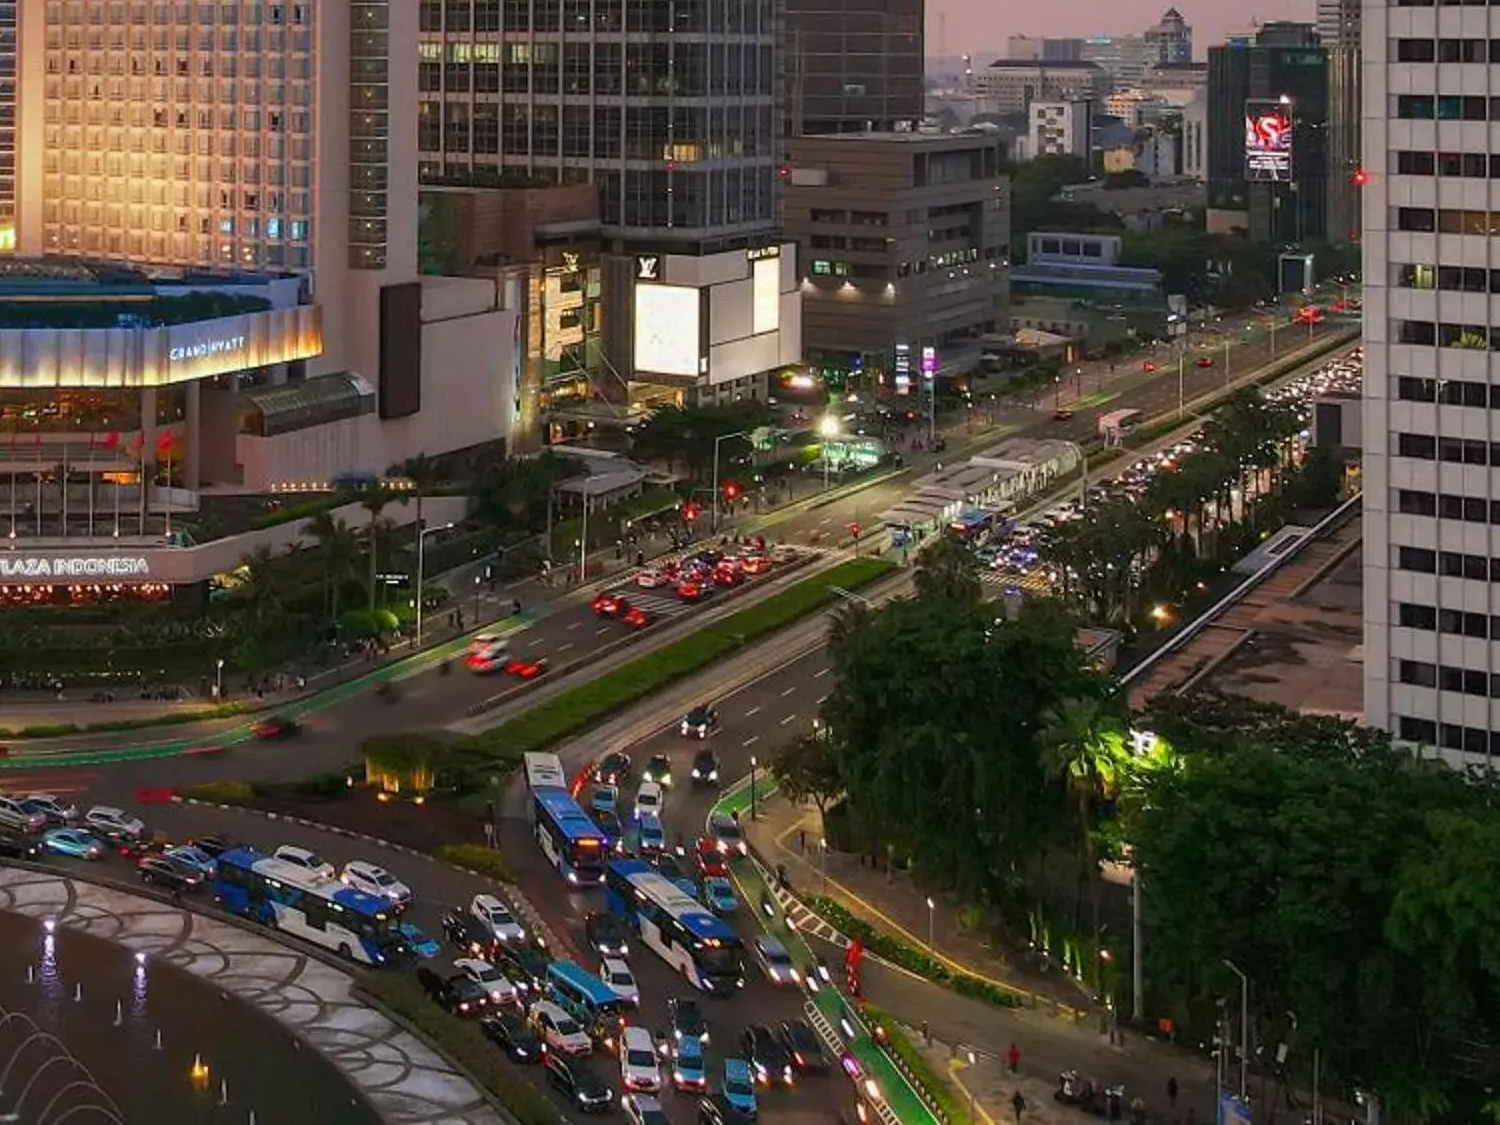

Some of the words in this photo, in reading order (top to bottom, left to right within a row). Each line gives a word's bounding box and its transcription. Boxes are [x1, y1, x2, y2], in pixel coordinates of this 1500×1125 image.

[170, 343, 207, 360] GRAND
[211, 336, 244, 352] HYATT
[53, 558, 148, 574] INDONESIA
